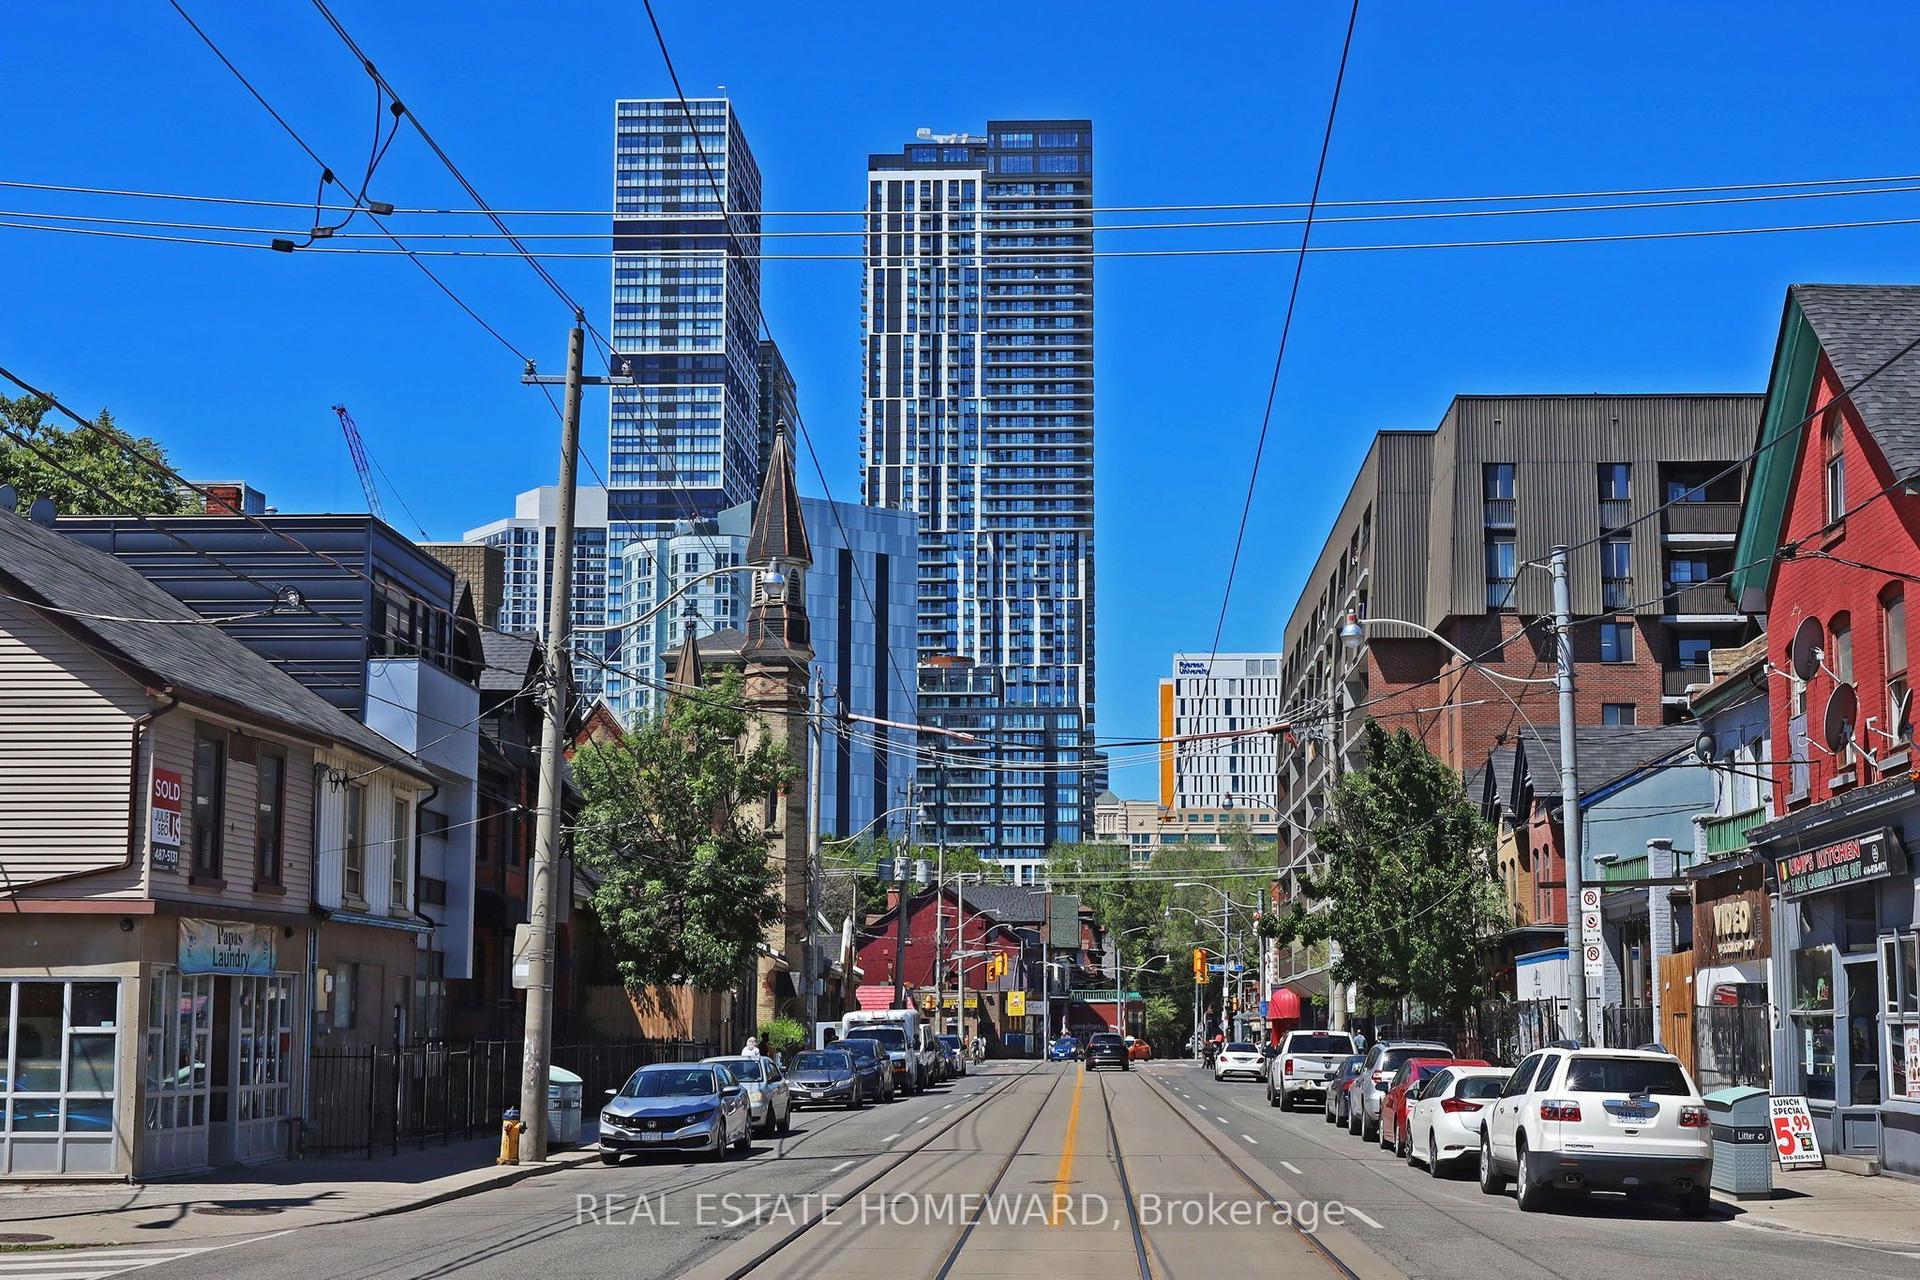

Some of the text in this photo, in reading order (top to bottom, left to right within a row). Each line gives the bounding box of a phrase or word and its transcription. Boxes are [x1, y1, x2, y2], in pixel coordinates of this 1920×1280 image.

[155, 779, 180, 801] SOLD
[157, 823, 169, 837] SEO
[1816, 838, 1861, 868] KITCHEN
[1834, 864, 1850, 882] TAKE
[1850, 860, 1862, 879] OUT
[1713, 900, 1751, 937] VIDEO
[217, 924, 243, 951] Papas
[212, 946, 250, 973] Laundry
[1773, 1098, 1800, 1107] LUNCH
[1773, 1107, 1805, 1116] SPECIAL
[1738, 1131, 1755, 1140] Litter
